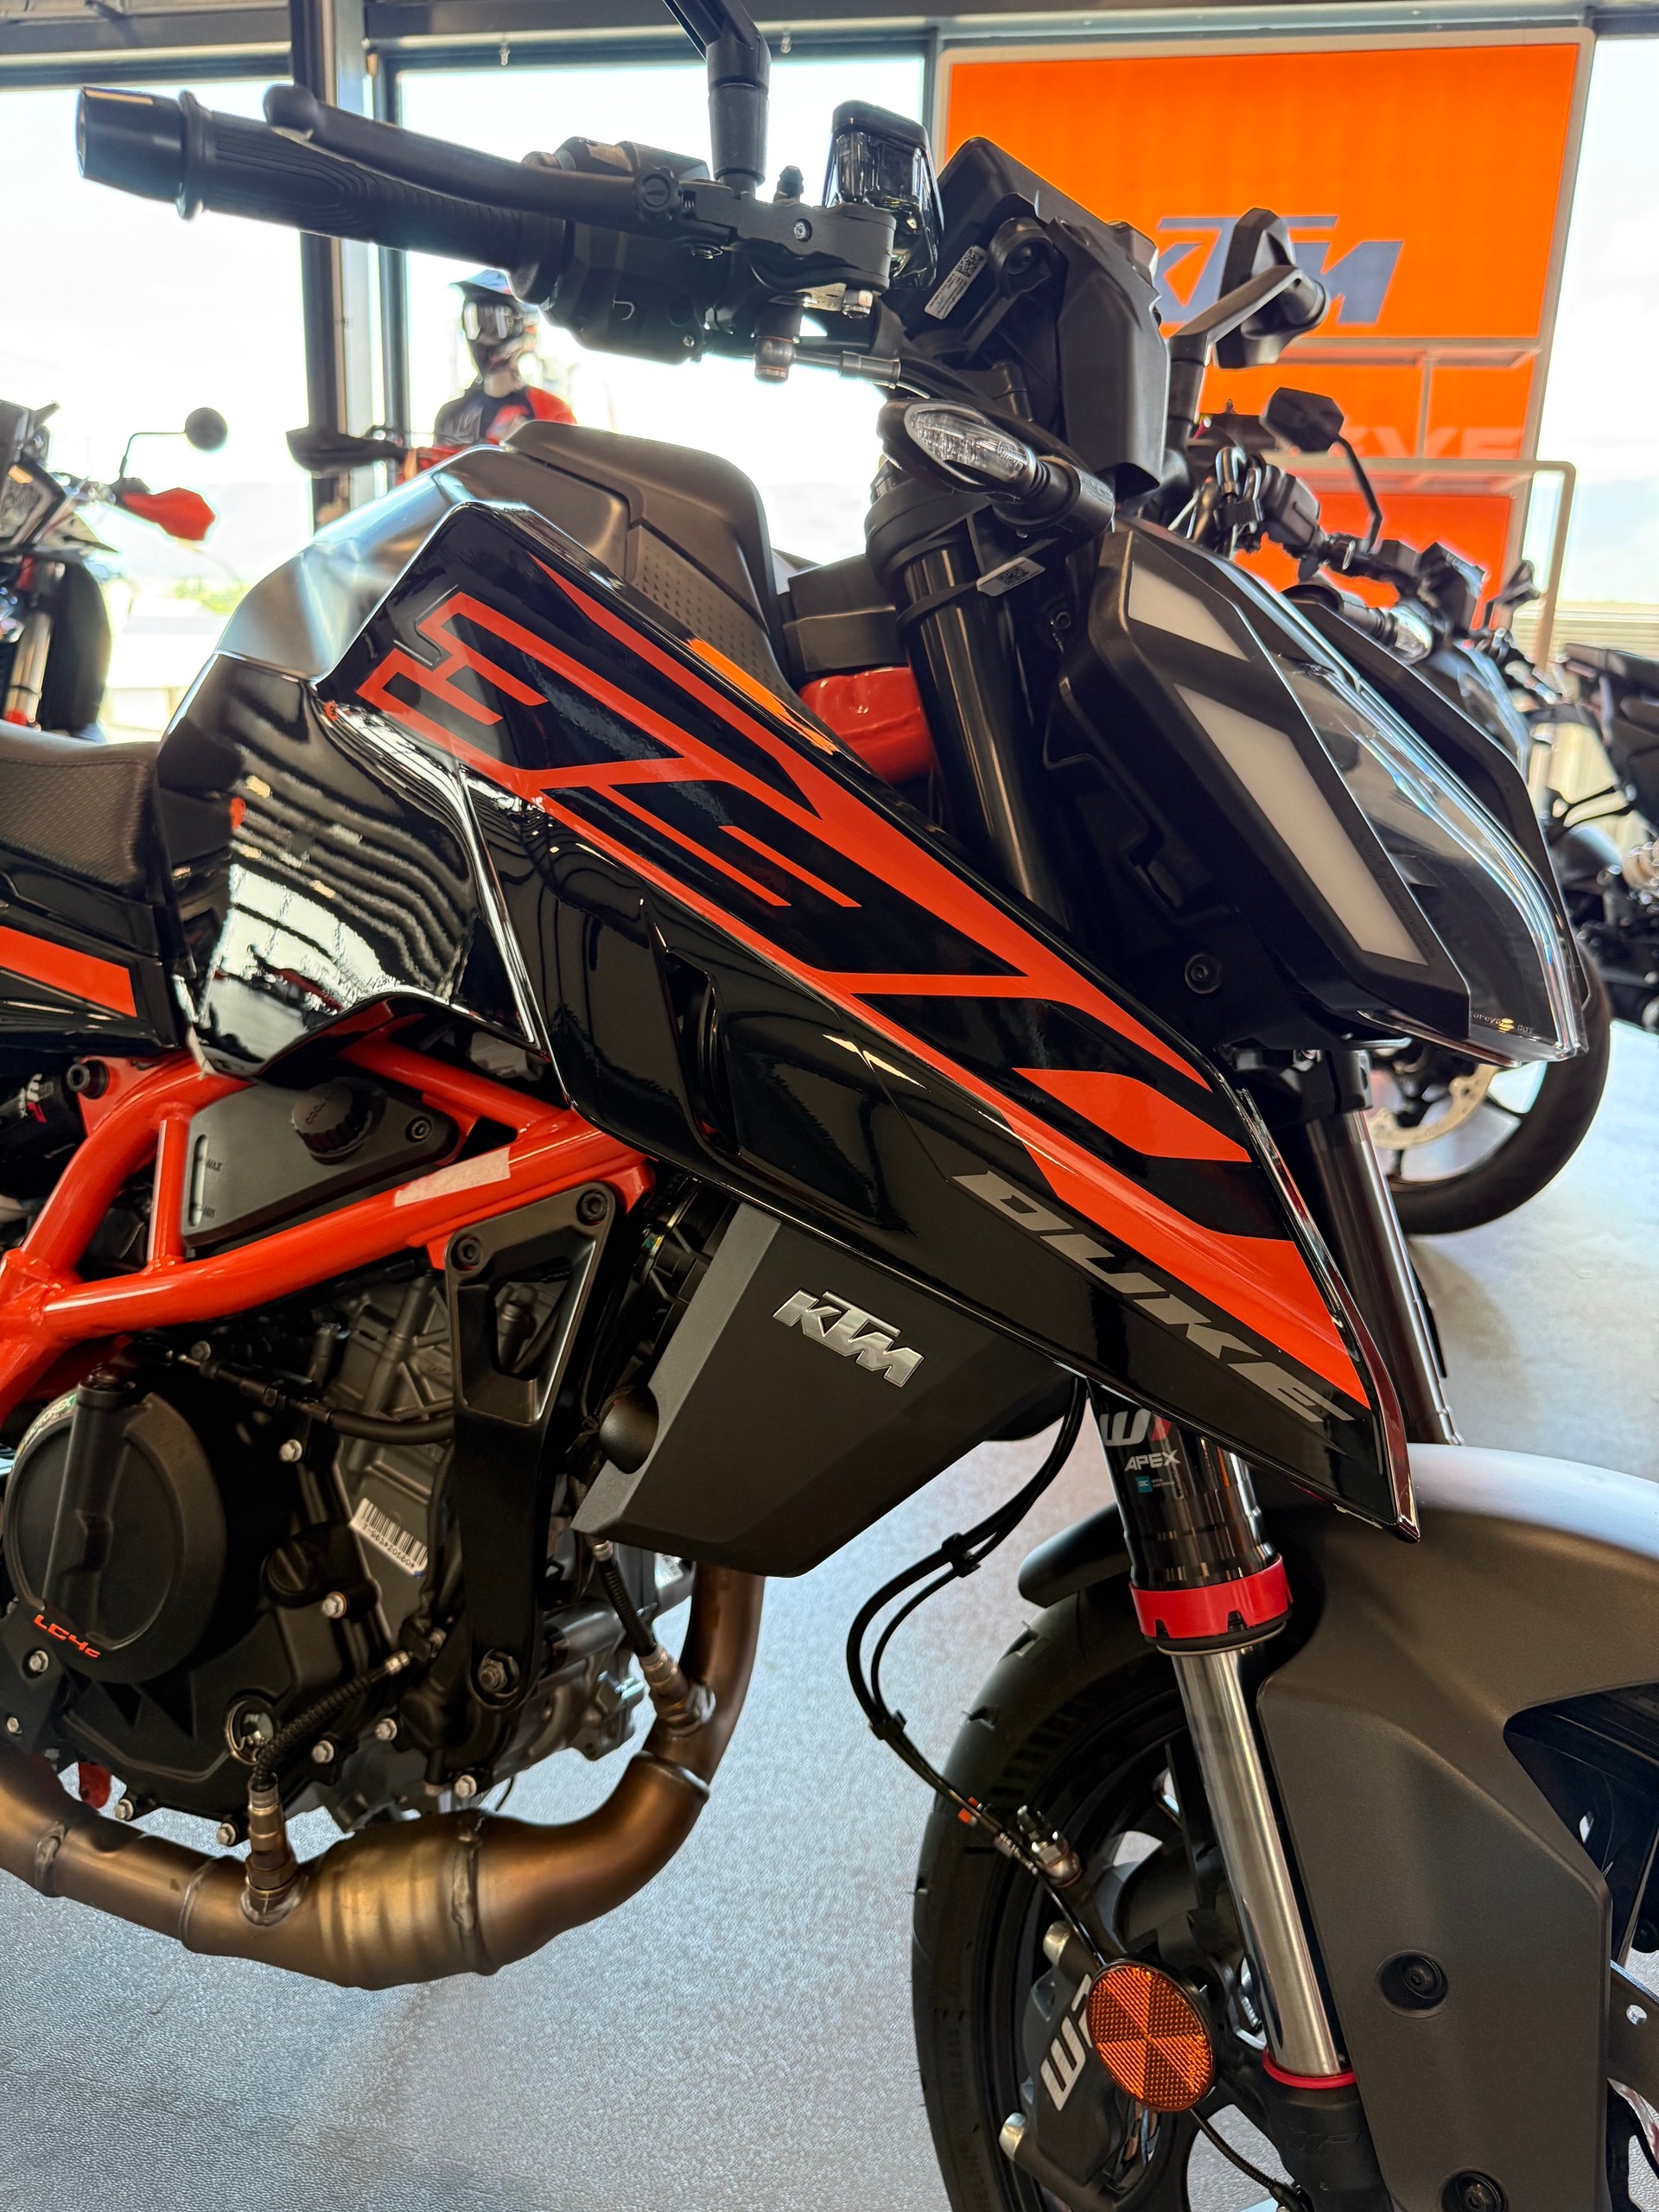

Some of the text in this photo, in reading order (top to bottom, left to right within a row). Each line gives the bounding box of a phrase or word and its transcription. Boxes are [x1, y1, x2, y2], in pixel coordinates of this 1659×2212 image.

[206, 1158, 223, 1173] MAX
[951, 1170, 1354, 1423] DUKE
[772, 1288, 925, 1389] KTM
[1123, 1448, 1182, 1472] APEX
